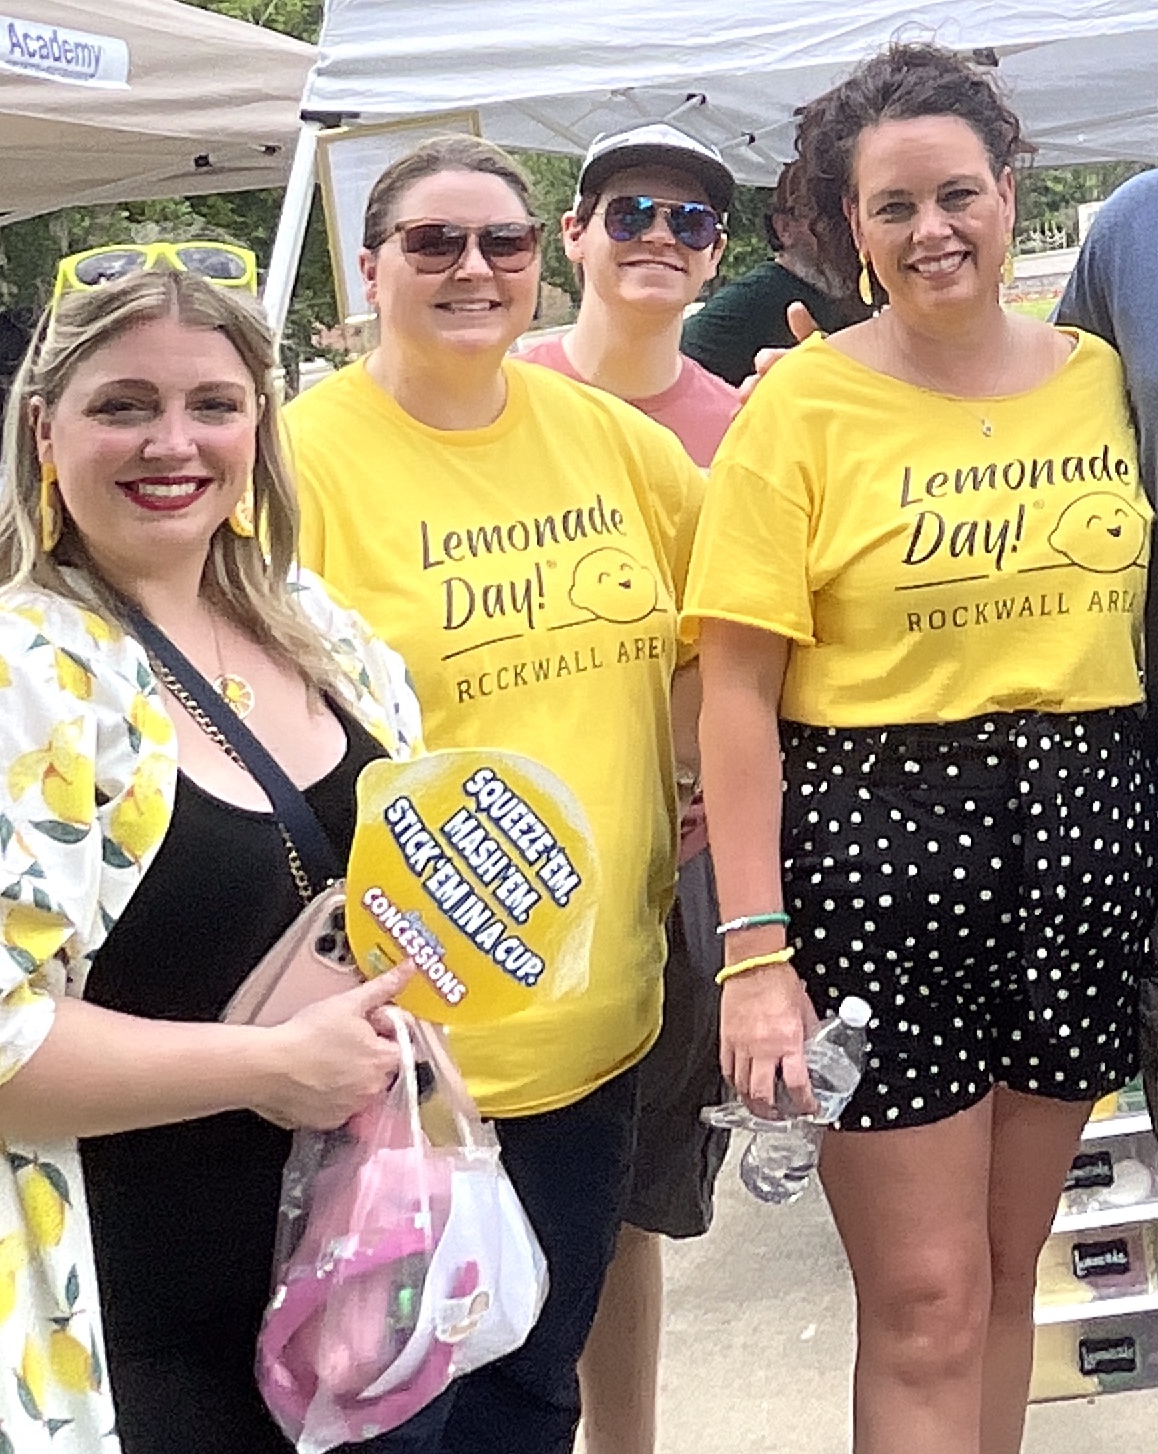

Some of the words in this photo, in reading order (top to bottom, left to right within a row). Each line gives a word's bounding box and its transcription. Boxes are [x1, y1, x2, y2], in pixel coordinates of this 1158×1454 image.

[7, 22, 102, 78] Academy
[900, 444, 1131, 508] Lemonade
[420, 494, 627, 570] Lemonade
[901, 504, 1026, 572] Day!
[441, 562, 546, 630] Day!
[906, 592, 1070, 634] ROCKWALL
[385, 797, 441, 875] STICK
[442, 808, 505, 886] MASH
[463, 767, 554, 866] SQUEEZE
[362, 886, 466, 1004] CONCESSIONS
